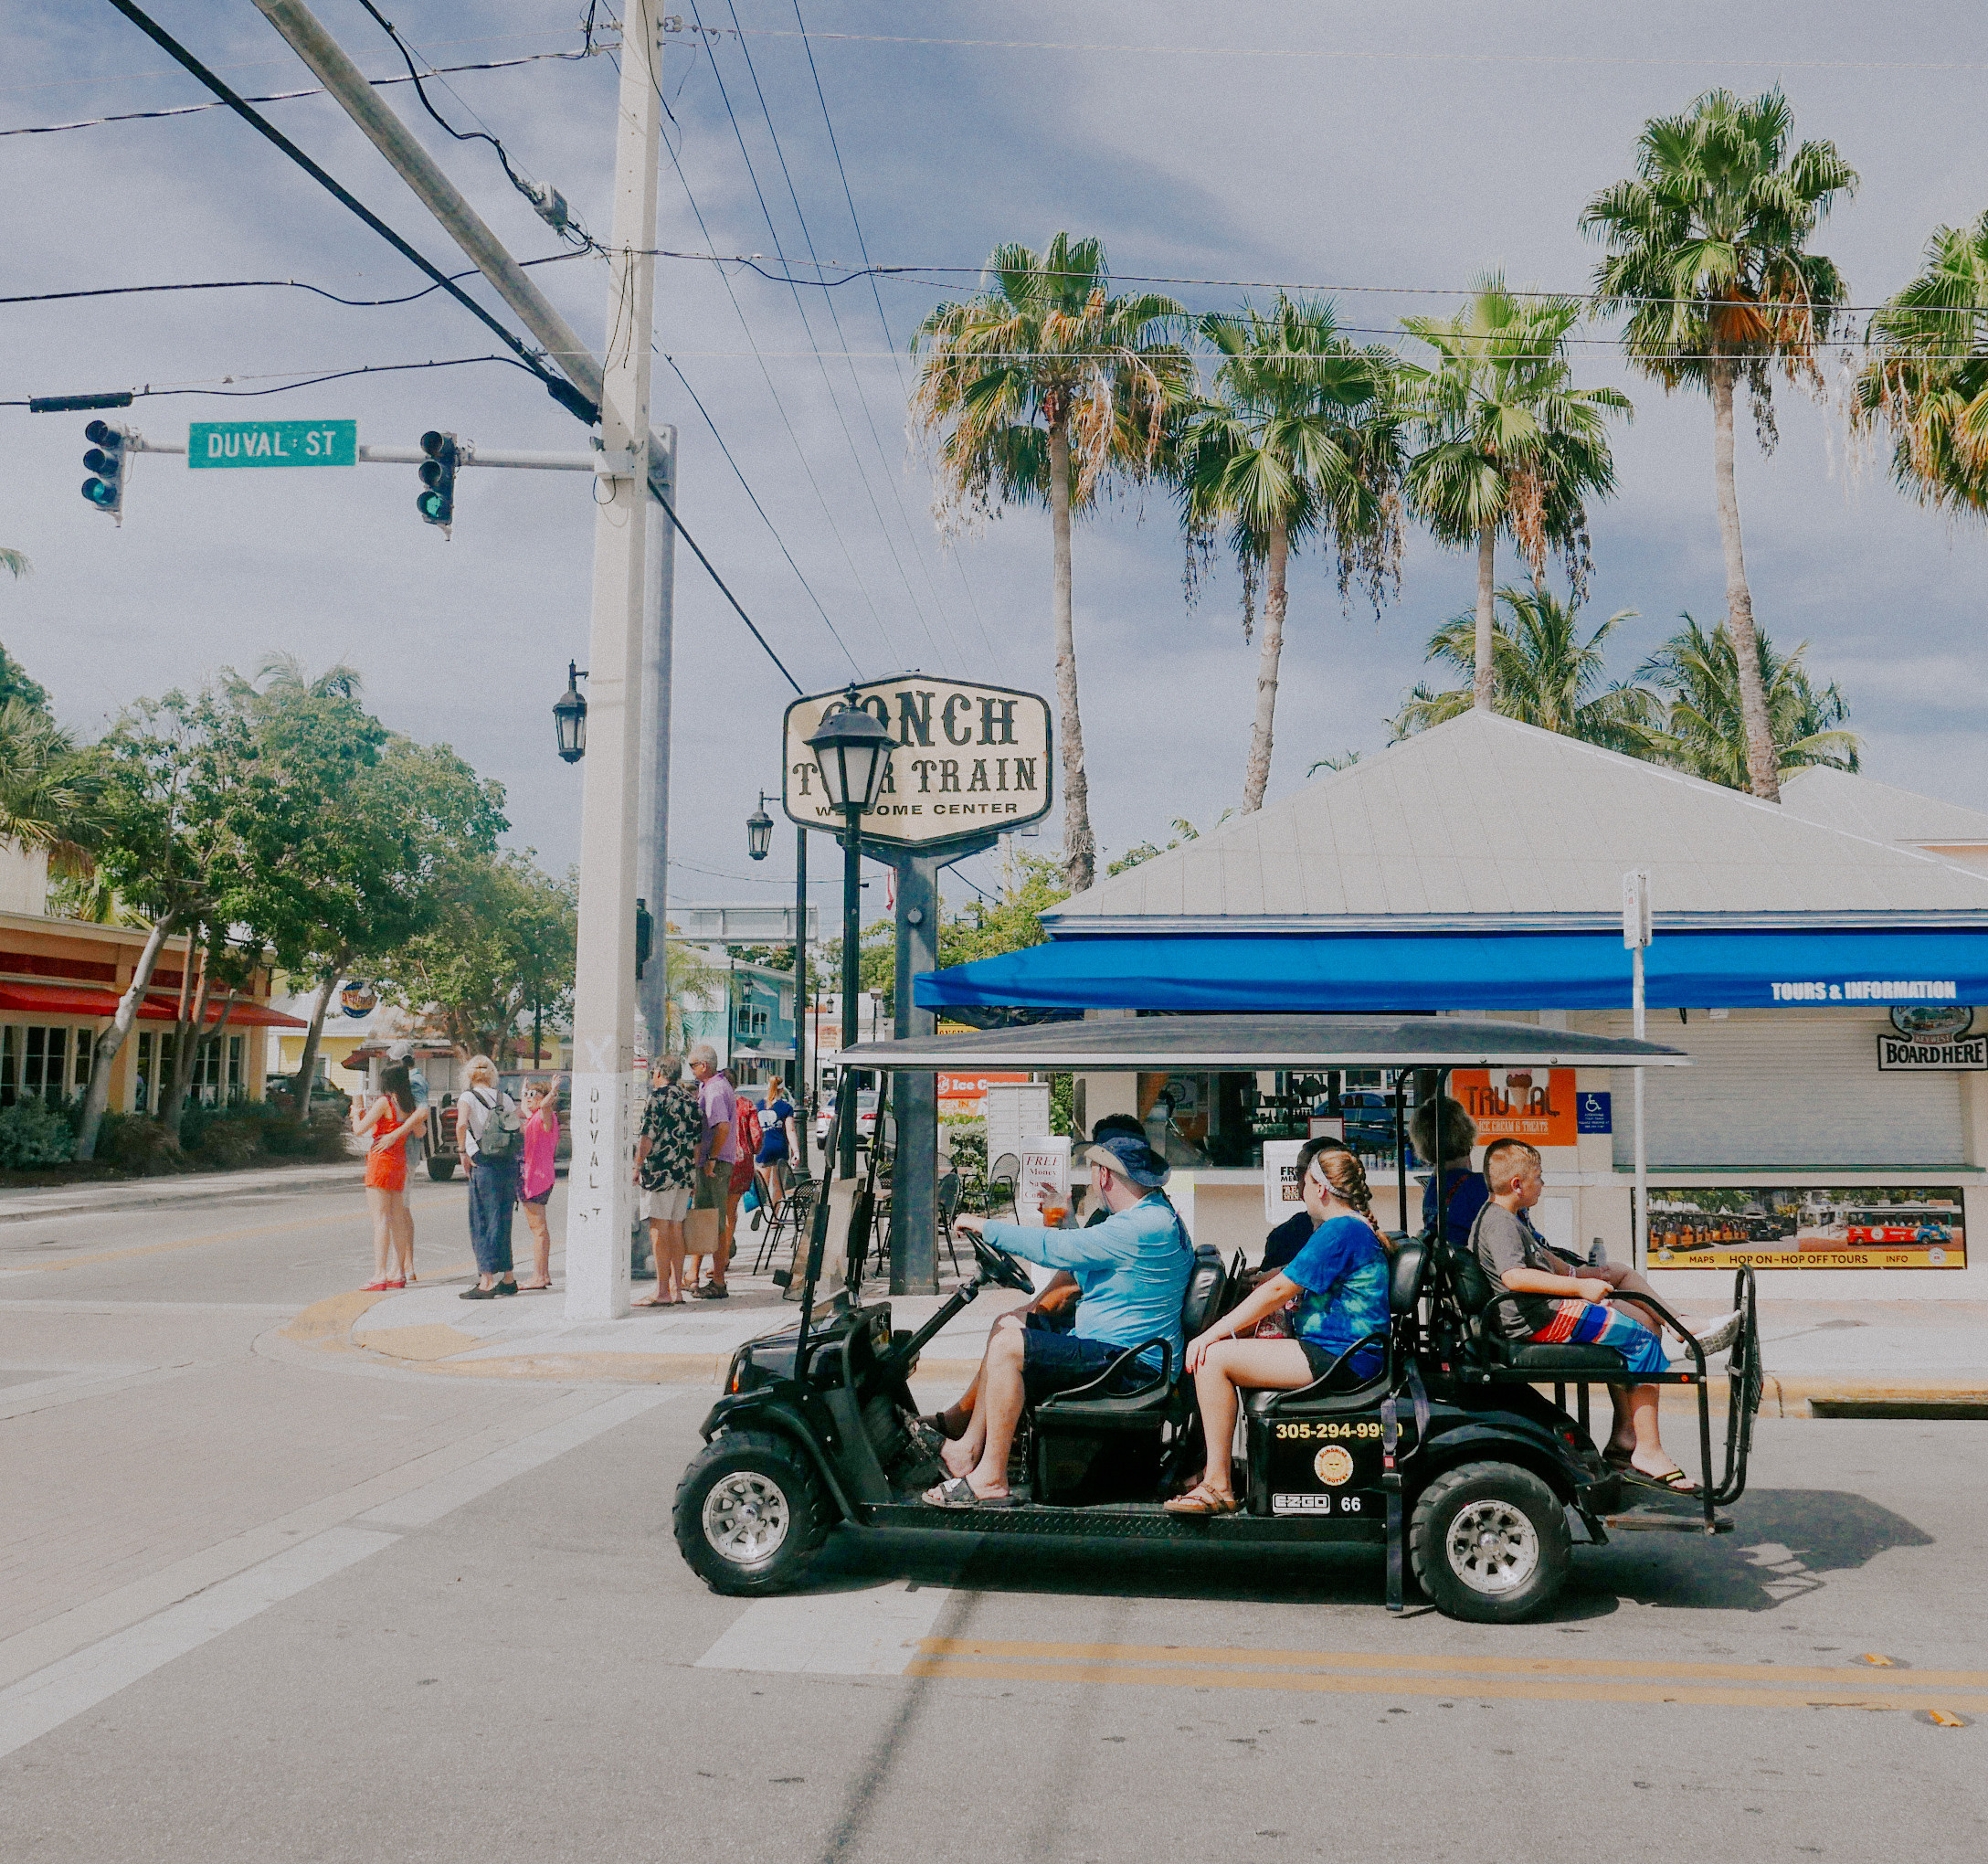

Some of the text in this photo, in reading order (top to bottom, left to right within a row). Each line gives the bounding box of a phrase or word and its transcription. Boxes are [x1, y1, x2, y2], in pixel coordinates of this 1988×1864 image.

[208, 431, 336, 458] DUVAL ST
[792, 757, 1037, 795] TR TRAIN
[815, 803, 1018, 817] WOME CENTER
[1771, 980, 1956, 1001] TOURS & INFORMATION
[1886, 1042, 1983, 1064] BOARD HERE
[953, 1078, 975, 1090] Ice
[1478, 1120, 1490, 1132] ICE
[1491, 1120, 1514, 1132] CREAM
[1521, 1120, 1549, 1132] TREATS
[589, 1087, 599, 1189] DUVAL
[1026, 1156, 1060, 1166] FREE
[1689, 1255, 1715, 1264] MAPS
[1729, 1255, 1752, 1265] HOP
[1755, 1255, 1772, 1264] ON
[1782, 1255, 1804, 1264] HOP
[1807, 1255, 1828, 1264] OFF
[1830, 1255, 1868, 1264] TOURS
[1886, 1255, 1909, 1264] INFO
[1275, 1423, 1403, 1439] 305-294-990
[1340, 1497, 1361, 1512] 66
